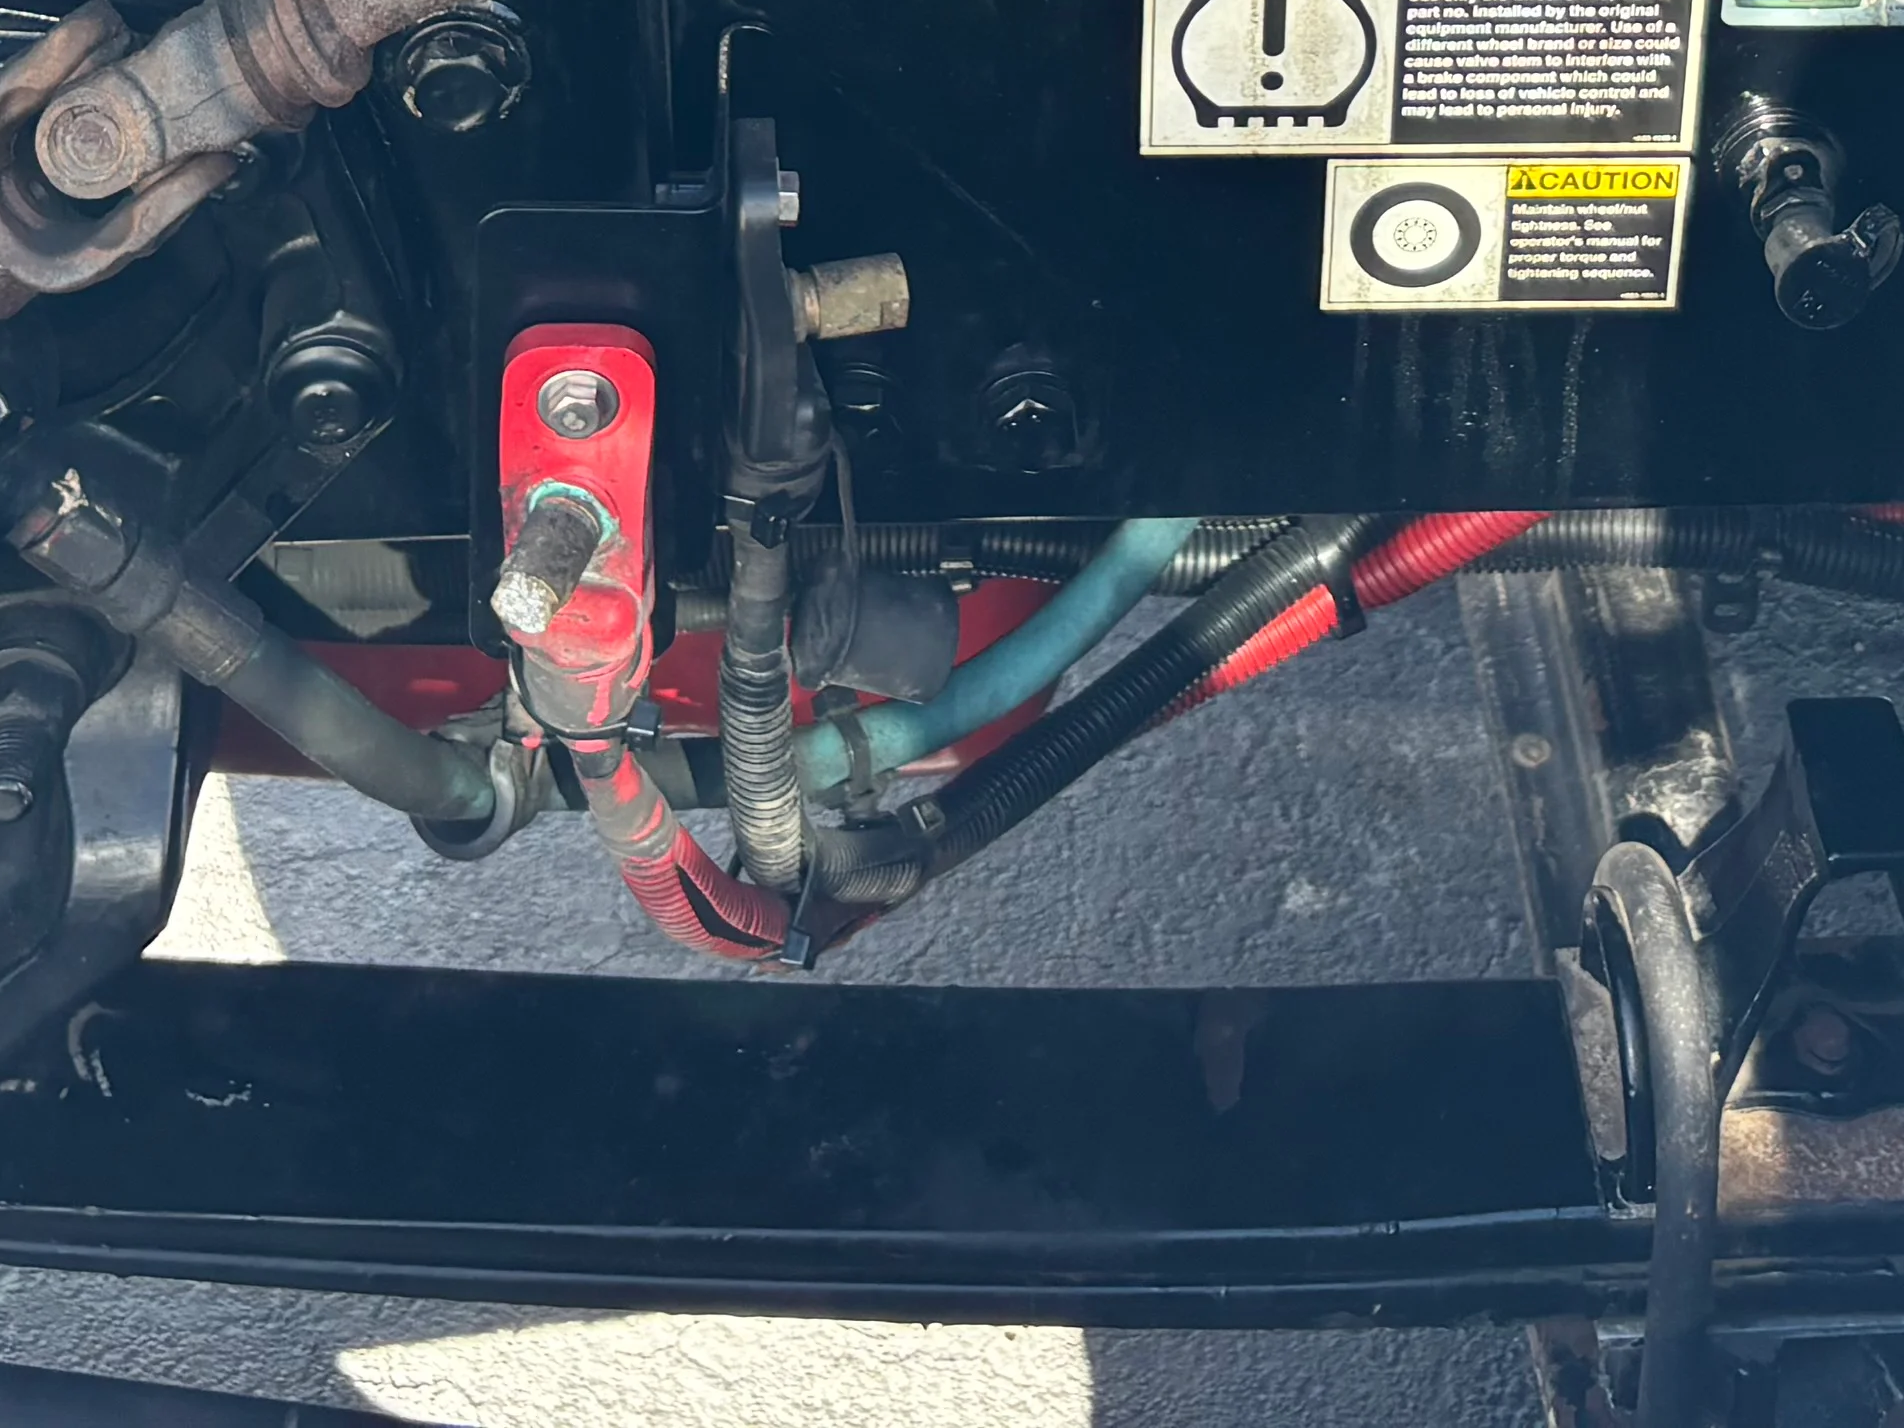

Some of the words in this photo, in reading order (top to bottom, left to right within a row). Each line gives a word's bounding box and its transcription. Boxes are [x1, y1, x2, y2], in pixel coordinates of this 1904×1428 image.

[1407, 6, 1440, 20] part
[1444, 6, 1468, 18] no.
[1546, 4, 1565, 20] by
[1570, 4, 1596, 17] the
[1599, 4, 1659, 20] original
[1406, 22, 1491, 36] equipment
[1496, 22, 1606, 34] manufacturer.
[1611, 22, 1642, 34] Use
[1646, 20, 1662, 33] of
[1666, 22, 1676, 33] a
[1406, 38, 1473, 52] different
[1476, 38, 1523, 51] wheel
[1527, 38, 1574, 50] brand
[1578, 40, 1594, 50] or
[1599, 37, 1632, 50] size
[1635, 36, 1680, 50] could
[1404, 56, 1453, 68] cause
[1456, 54, 1497, 67] valve
[1502, 55, 1542, 67] stem
[1546, 54, 1562, 67] to
[1637, 54, 1671, 66] with
[1404, 73, 1414, 84] a
[1417, 72, 1462, 84] brake
[1466, 72, 1556, 86] component
[1560, 70, 1608, 83] which
[1611, 70, 1656, 83] could
[1402, 88, 1437, 101] lead
[1441, 88, 1456, 100] to
[1461, 88, 1494, 100] loss
[1498, 87, 1515, 99] of
[1518, 87, 1575, 100] vehicle
[1578, 86, 1635, 99] control
[1639, 86, 1670, 99] and
[1402, 105, 1436, 120] may
[1440, 104, 1474, 117] lead
[1477, 104, 1493, 116] to
[1496, 104, 1566, 118] personal
[1539, 171, 1673, 190] CAUTION
[1513, 204, 1574, 215] Maintain
[1577, 204, 1648, 215] wheel/nut
[1511, 220, 1581, 233] tightness.
[1584, 220, 1612, 231] See
[1510, 236, 1584, 248] operator's
[1586, 236, 1639, 246] manual
[1642, 235, 1663, 246] for
[1508, 252, 1557, 264] proper
[1560, 252, 1607, 264] torque
[1609, 252, 1637, 262] and
[1508, 268, 1579, 280] tightening
[1582, 269, 1654, 280] sequence.
